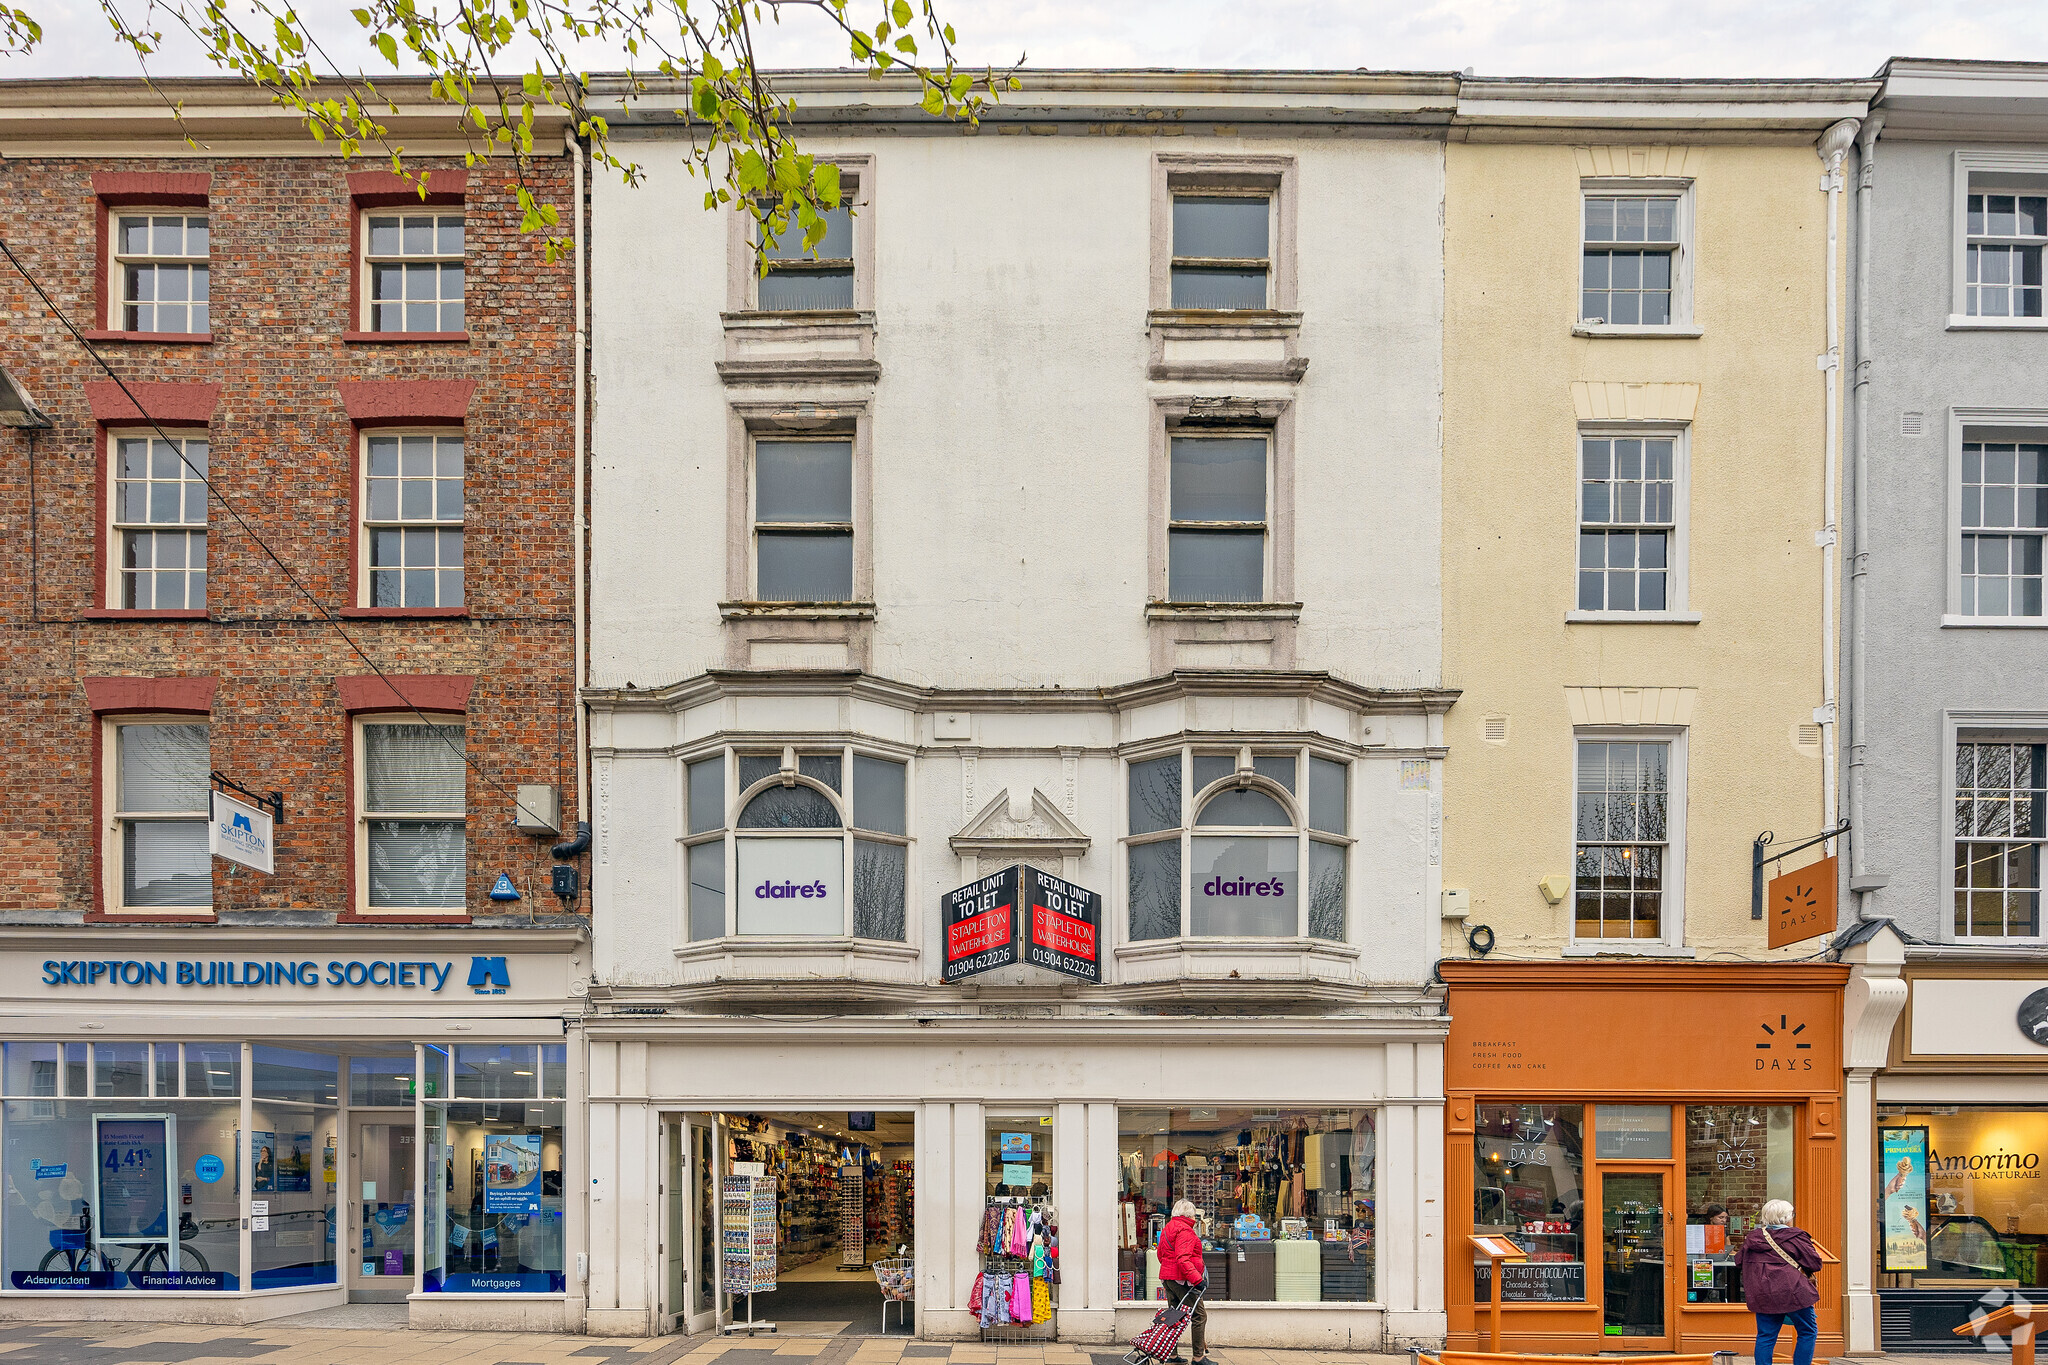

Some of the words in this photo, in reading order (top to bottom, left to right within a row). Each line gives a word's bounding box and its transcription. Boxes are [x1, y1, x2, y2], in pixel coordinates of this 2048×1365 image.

[221, 823, 265, 848] SKIPTON
[755, 880, 826, 898] claire's
[952, 884, 980, 904] RETAIL
[982, 873, 1005, 891] UNIT
[1037, 873, 1067, 896] RETAIL
[1069, 886, 1091, 903] UNIT
[1203, 876, 1284, 896] claire's
[959, 901, 975, 919] TO
[977, 891, 998, 912] LET
[1045, 891, 1062, 910] TO
[1064, 899, 1084, 918] LET
[952, 911, 1007, 940] STAPLETON
[1037, 912, 1092, 941] STAPLETON
[1781, 911, 1816, 929] DAYS
[952, 929, 1005, 954] WATERHOUSE
[1037, 929, 1092, 955] WATERHOUSE
[948, 959, 974, 977] 01904
[976, 948, 1010, 968] 622226
[1032, 948, 1061, 967] 01904
[1063, 958, 1095, 977] 622226
[42, 960, 167, 986] SKIPTON
[175, 961, 319, 986] BUILDING
[326, 960, 453, 992] SOCIETY
[1755, 1058, 1812, 1071] DAYS
[105, 1149, 152, 1173] 4.41%
[1511, 1148, 1546, 1160] DAYS
[1717, 1152, 1755, 1163] DAYS
[1928, 1148, 2039, 1170] Amorino
[143, 1276, 183, 1285] Financial
[185, 1276, 216, 1285] Advice
[471, 1279, 521, 1289] Mortgages
[1518, 1267, 1533, 1279] HOT
